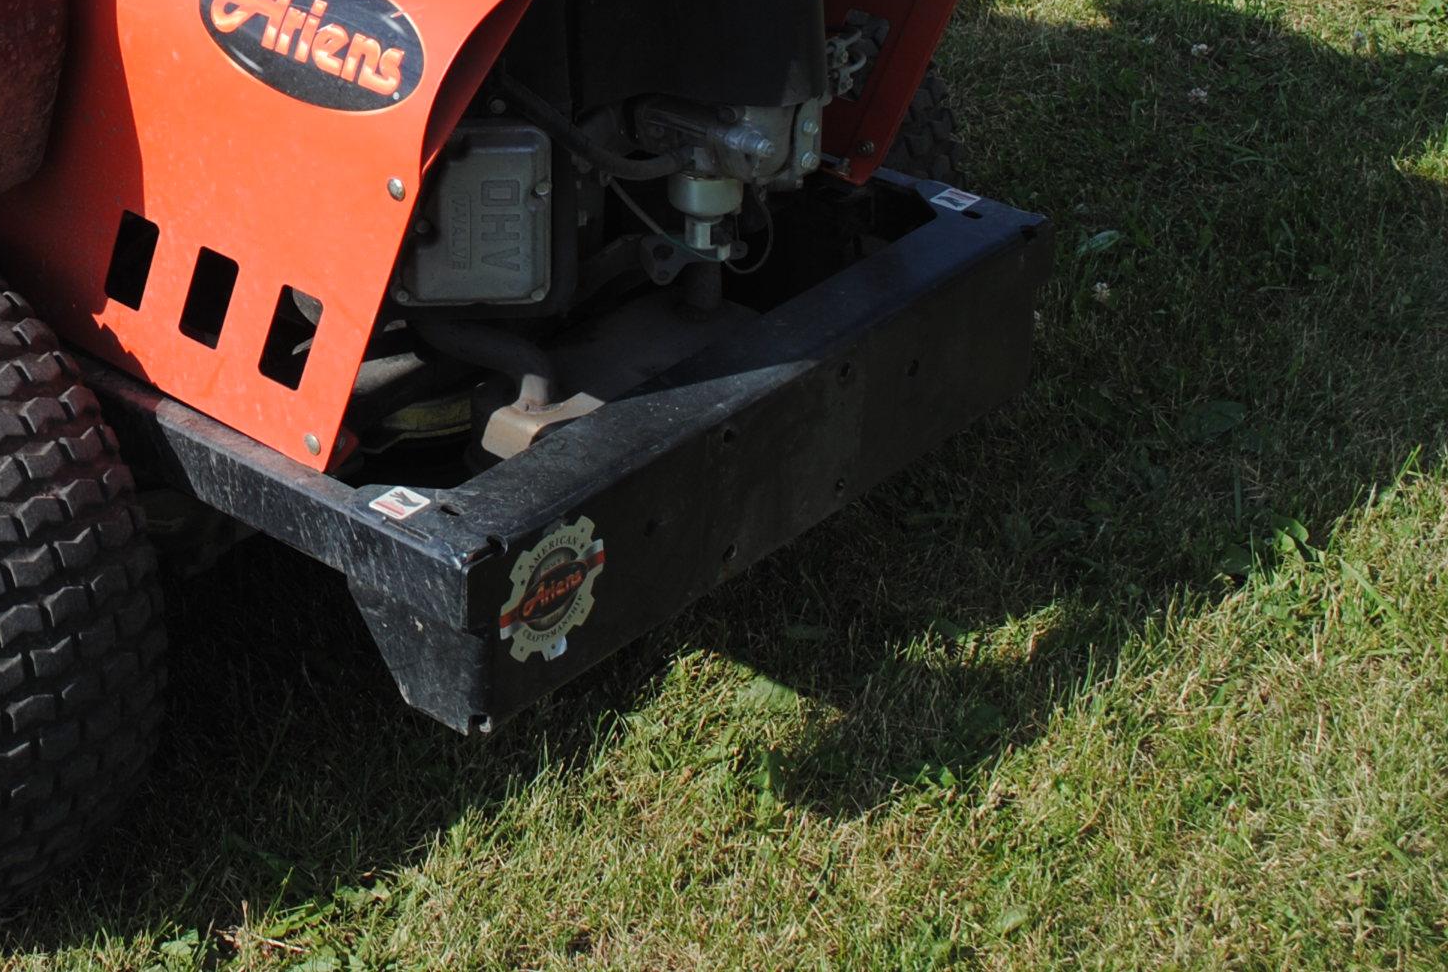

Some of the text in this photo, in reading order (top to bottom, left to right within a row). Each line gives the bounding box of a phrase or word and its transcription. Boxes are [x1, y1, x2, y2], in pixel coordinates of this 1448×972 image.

[481, 179, 520, 271] OHV
[528, 535, 580, 573] AMERICAN
[522, 569, 584, 617] Ariens
